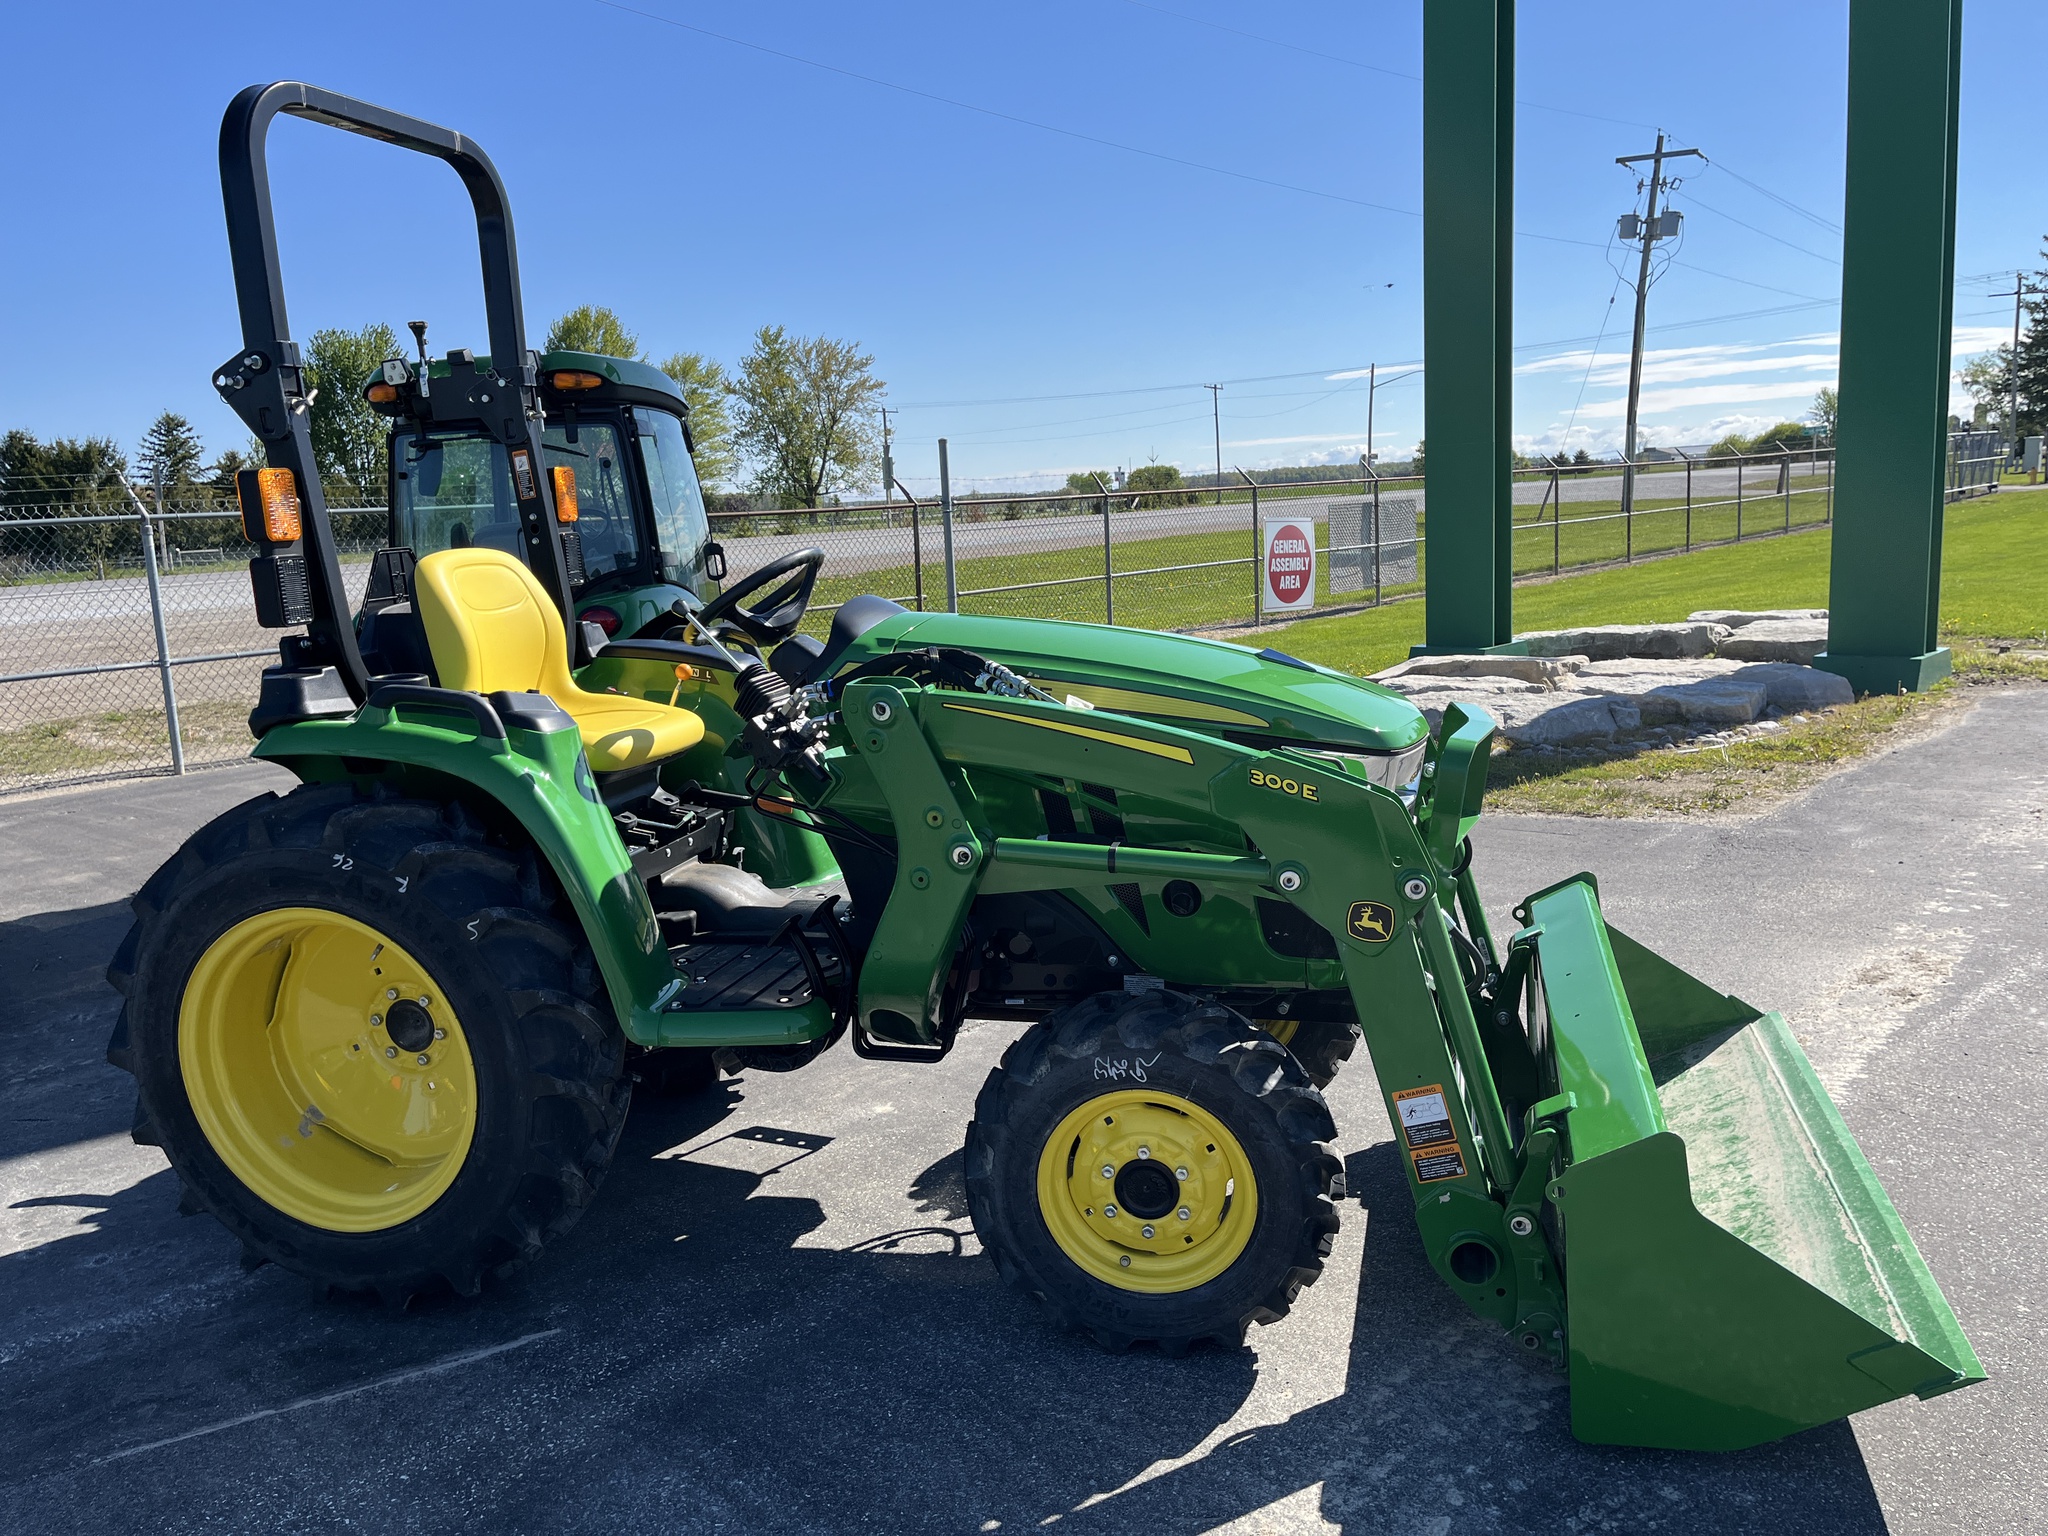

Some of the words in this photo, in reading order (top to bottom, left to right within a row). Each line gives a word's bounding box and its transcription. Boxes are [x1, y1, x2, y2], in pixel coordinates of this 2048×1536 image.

[1273, 539, 1307, 554] GENERAL
[1270, 556, 1310, 573] ASSEMBLY
[1279, 574, 1301, 590] AREA
[1405, 1087, 1437, 1098] WARNING
[1423, 1146, 1455, 1157] WARNING
